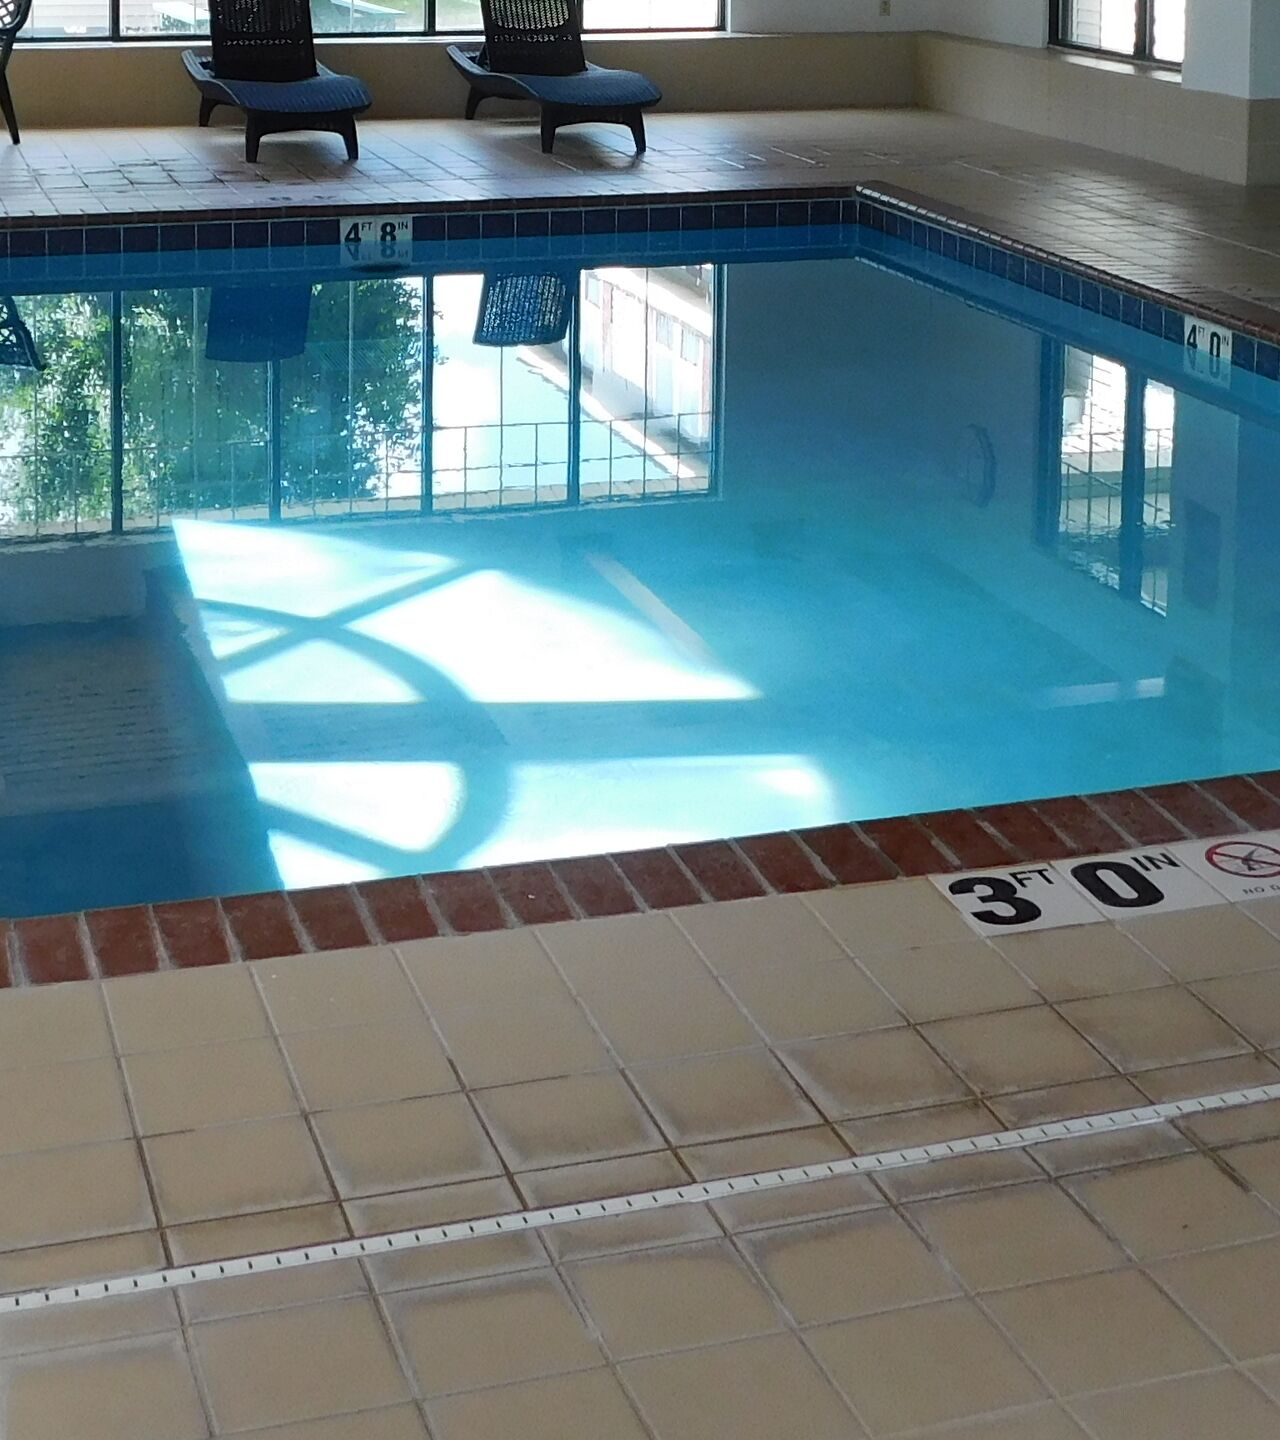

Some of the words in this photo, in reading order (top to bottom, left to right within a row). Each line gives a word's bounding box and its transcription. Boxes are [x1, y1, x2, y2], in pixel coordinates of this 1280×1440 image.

[345, 222, 362, 243] 4
[362, 221, 373, 231] FT
[380, 222, 397, 242] 8
[398, 220, 409, 230] IN
[1186, 324, 1198, 349] 4
[1209, 331, 1221, 358] 0
[948, 876, 1042, 926] 3
[1008, 868, 1055, 888] FT
[1070, 861, 1165, 908] 0
[1130, 852, 1181, 872] IN
[1242, 886, 1265, 895] NO
